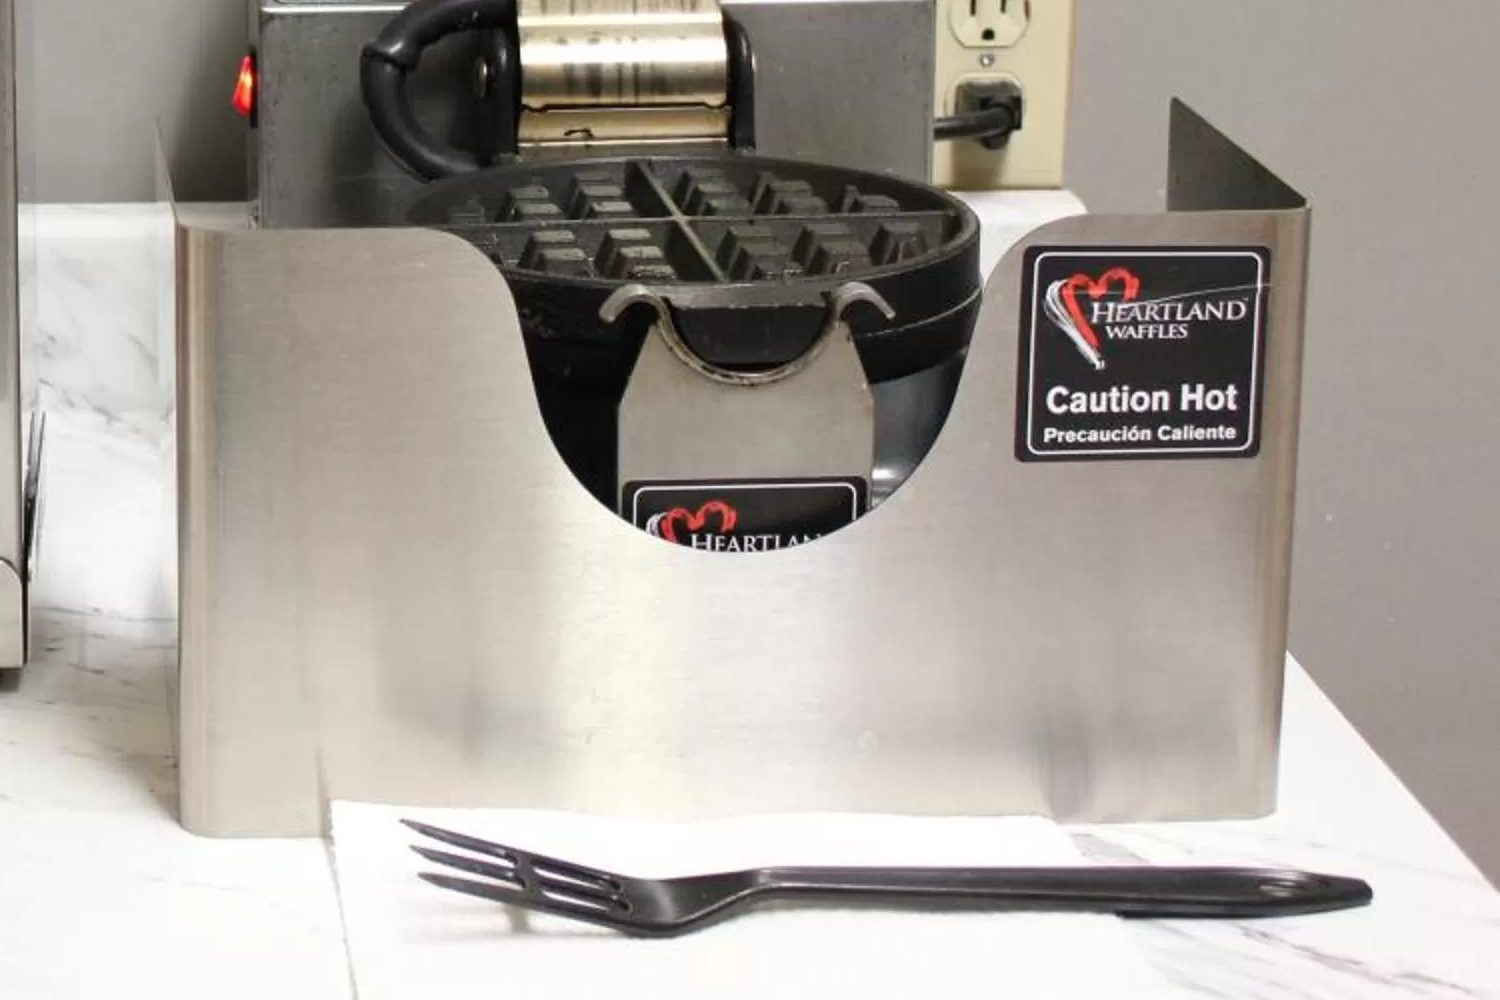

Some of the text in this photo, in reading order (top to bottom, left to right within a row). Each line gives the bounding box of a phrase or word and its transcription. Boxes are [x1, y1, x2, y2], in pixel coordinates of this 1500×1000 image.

[1091, 300, 1248, 324] HEARTLAND
[1105, 323, 1188, 339] WAFFLES
[1046, 384, 1238, 413] Caution Hot
[1043, 425, 1237, 443] Precaución Caliente
[690, 533, 821, 552] HEARTLA
